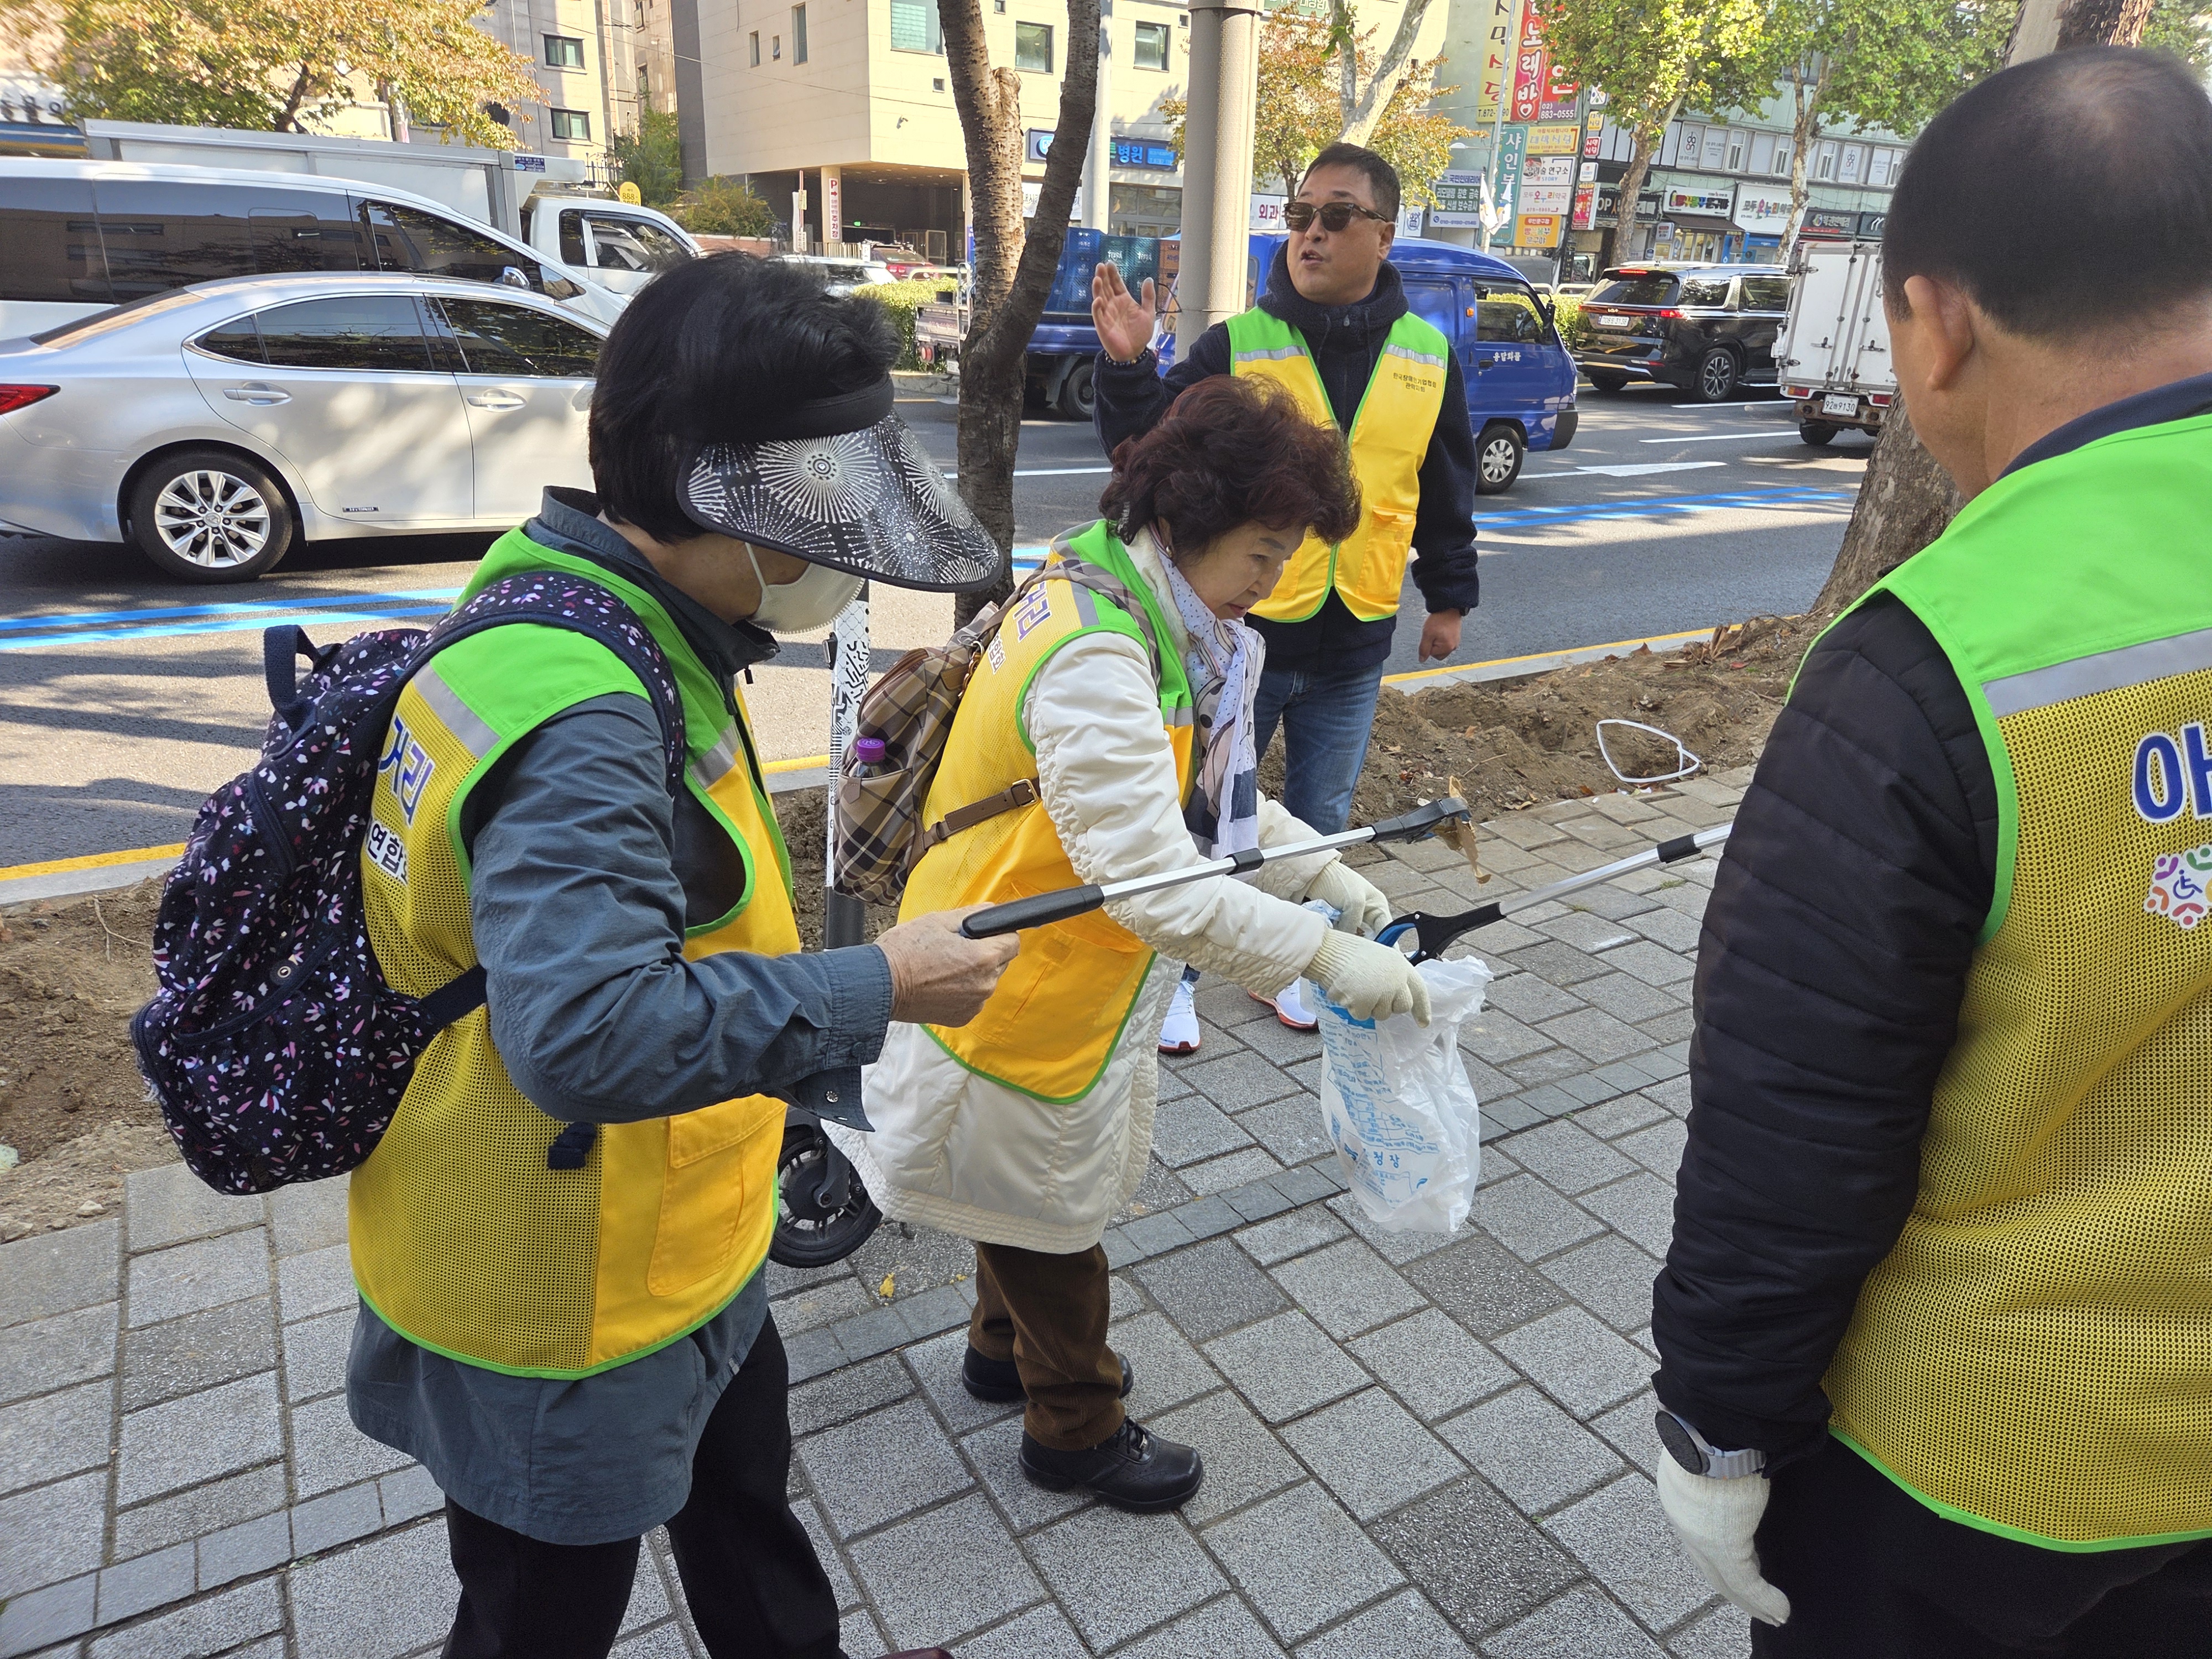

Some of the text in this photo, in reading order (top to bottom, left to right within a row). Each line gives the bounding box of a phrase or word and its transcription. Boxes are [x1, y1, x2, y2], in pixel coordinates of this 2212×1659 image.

[1517, 0, 1543, 118] 노래방
[1541, 110, 1574, 119] 883-0555
[1548, 166, 1568, 175] 연구소
[831, 180, 837, 189] P
[1523, 191, 1567, 203] 모두온누리약국
[1458, 200, 1478, 211] 보수공사
[1259, 204, 1279, 220] 외과
[1493, 352, 1521, 362] 용달화물
[1393, 372, 1437, 388] 한국장애인기업협회
[1013, 582, 1051, 643] 거리
[379, 714, 435, 826] 거리
